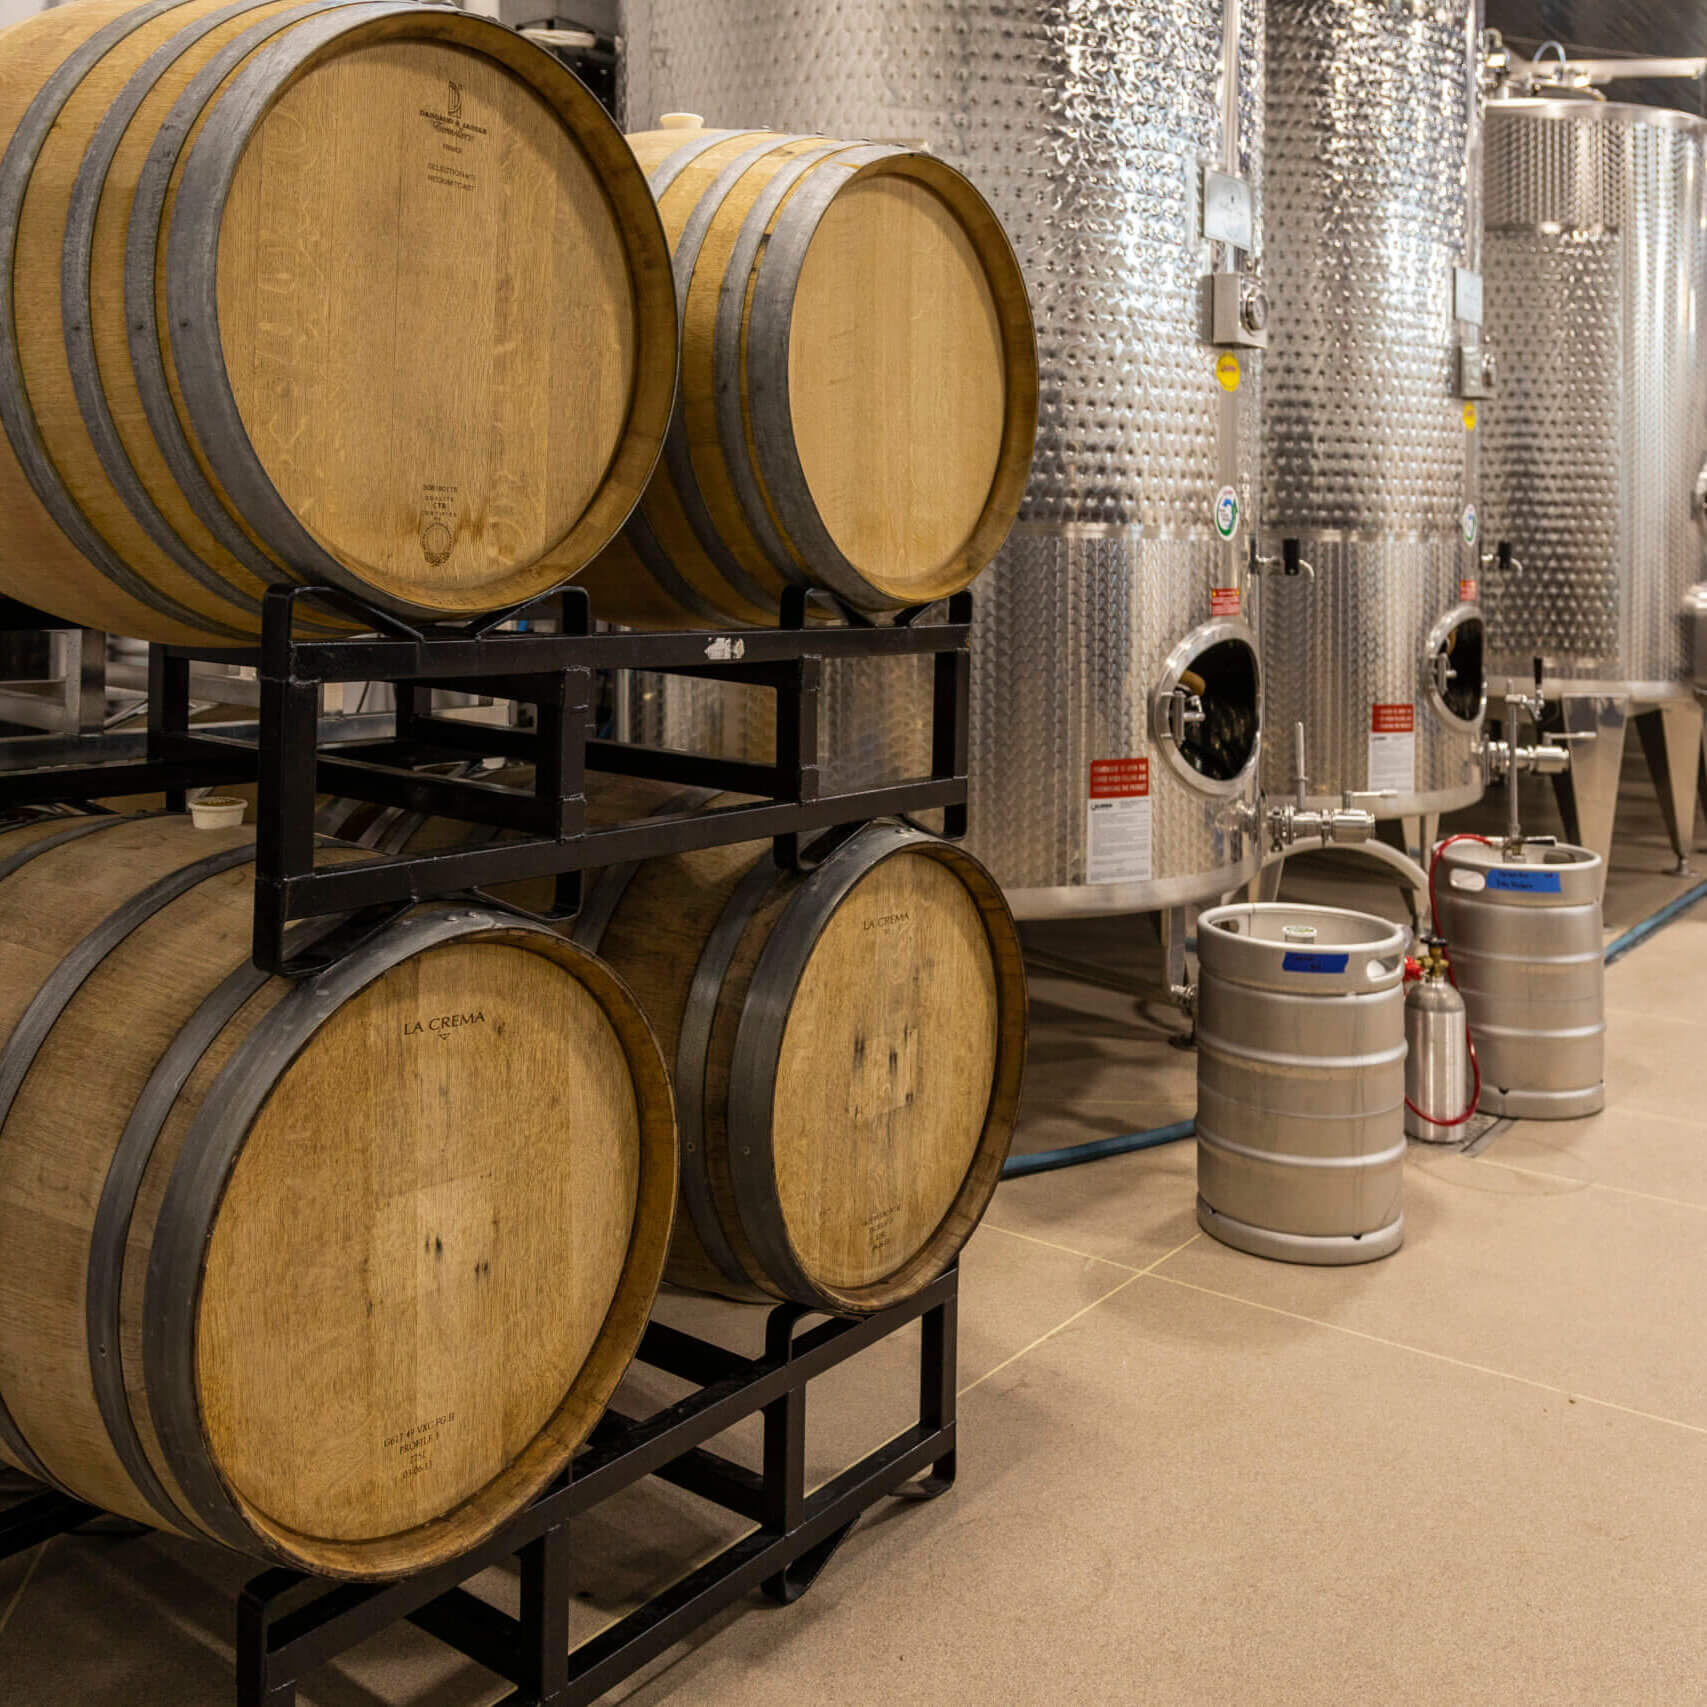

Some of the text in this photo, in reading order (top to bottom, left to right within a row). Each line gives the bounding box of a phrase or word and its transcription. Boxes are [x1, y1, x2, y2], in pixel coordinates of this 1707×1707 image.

[863, 912, 910, 931] LA CREMA
[404, 1011, 486, 1035] LA CREMA
